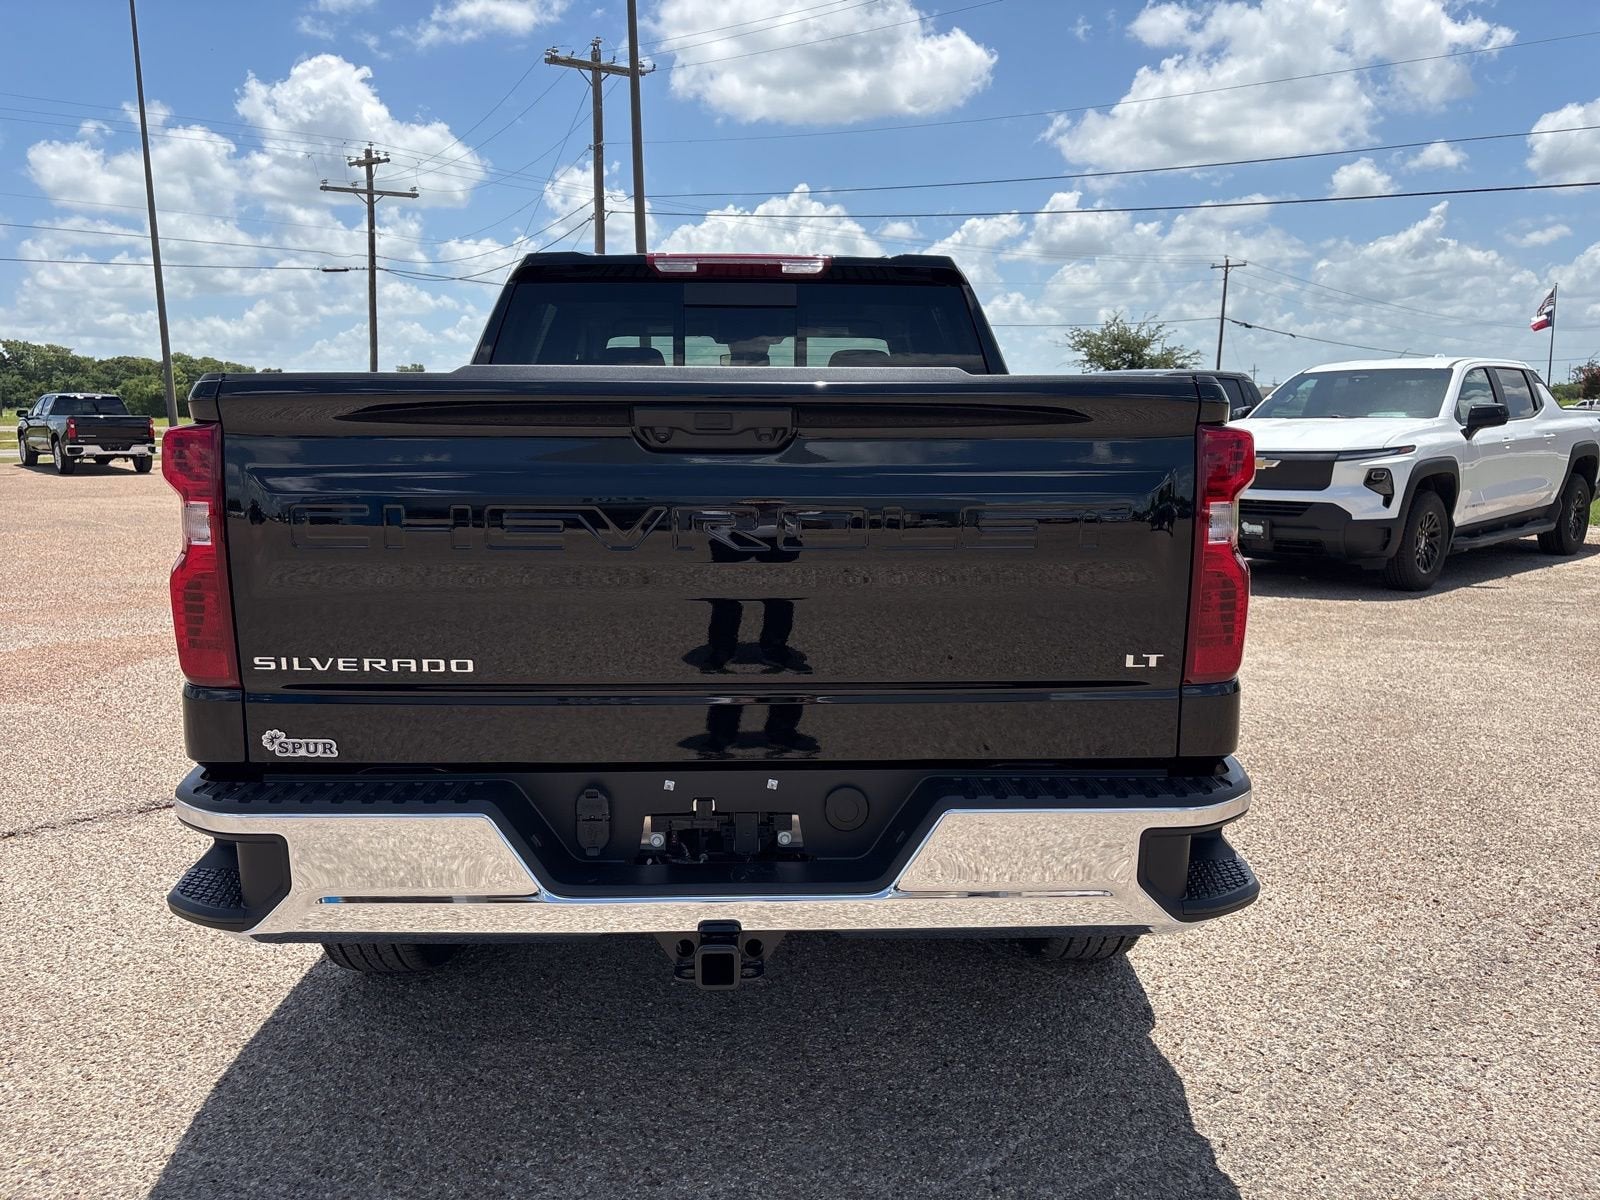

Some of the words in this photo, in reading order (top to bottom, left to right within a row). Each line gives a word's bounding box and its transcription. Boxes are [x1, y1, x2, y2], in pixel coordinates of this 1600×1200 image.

[289, 503, 1133, 551] CHEVROLET
[253, 656, 475, 673] SILVERADO
[1125, 653, 1165, 668] LT
[278, 741, 335, 755] SPUR
